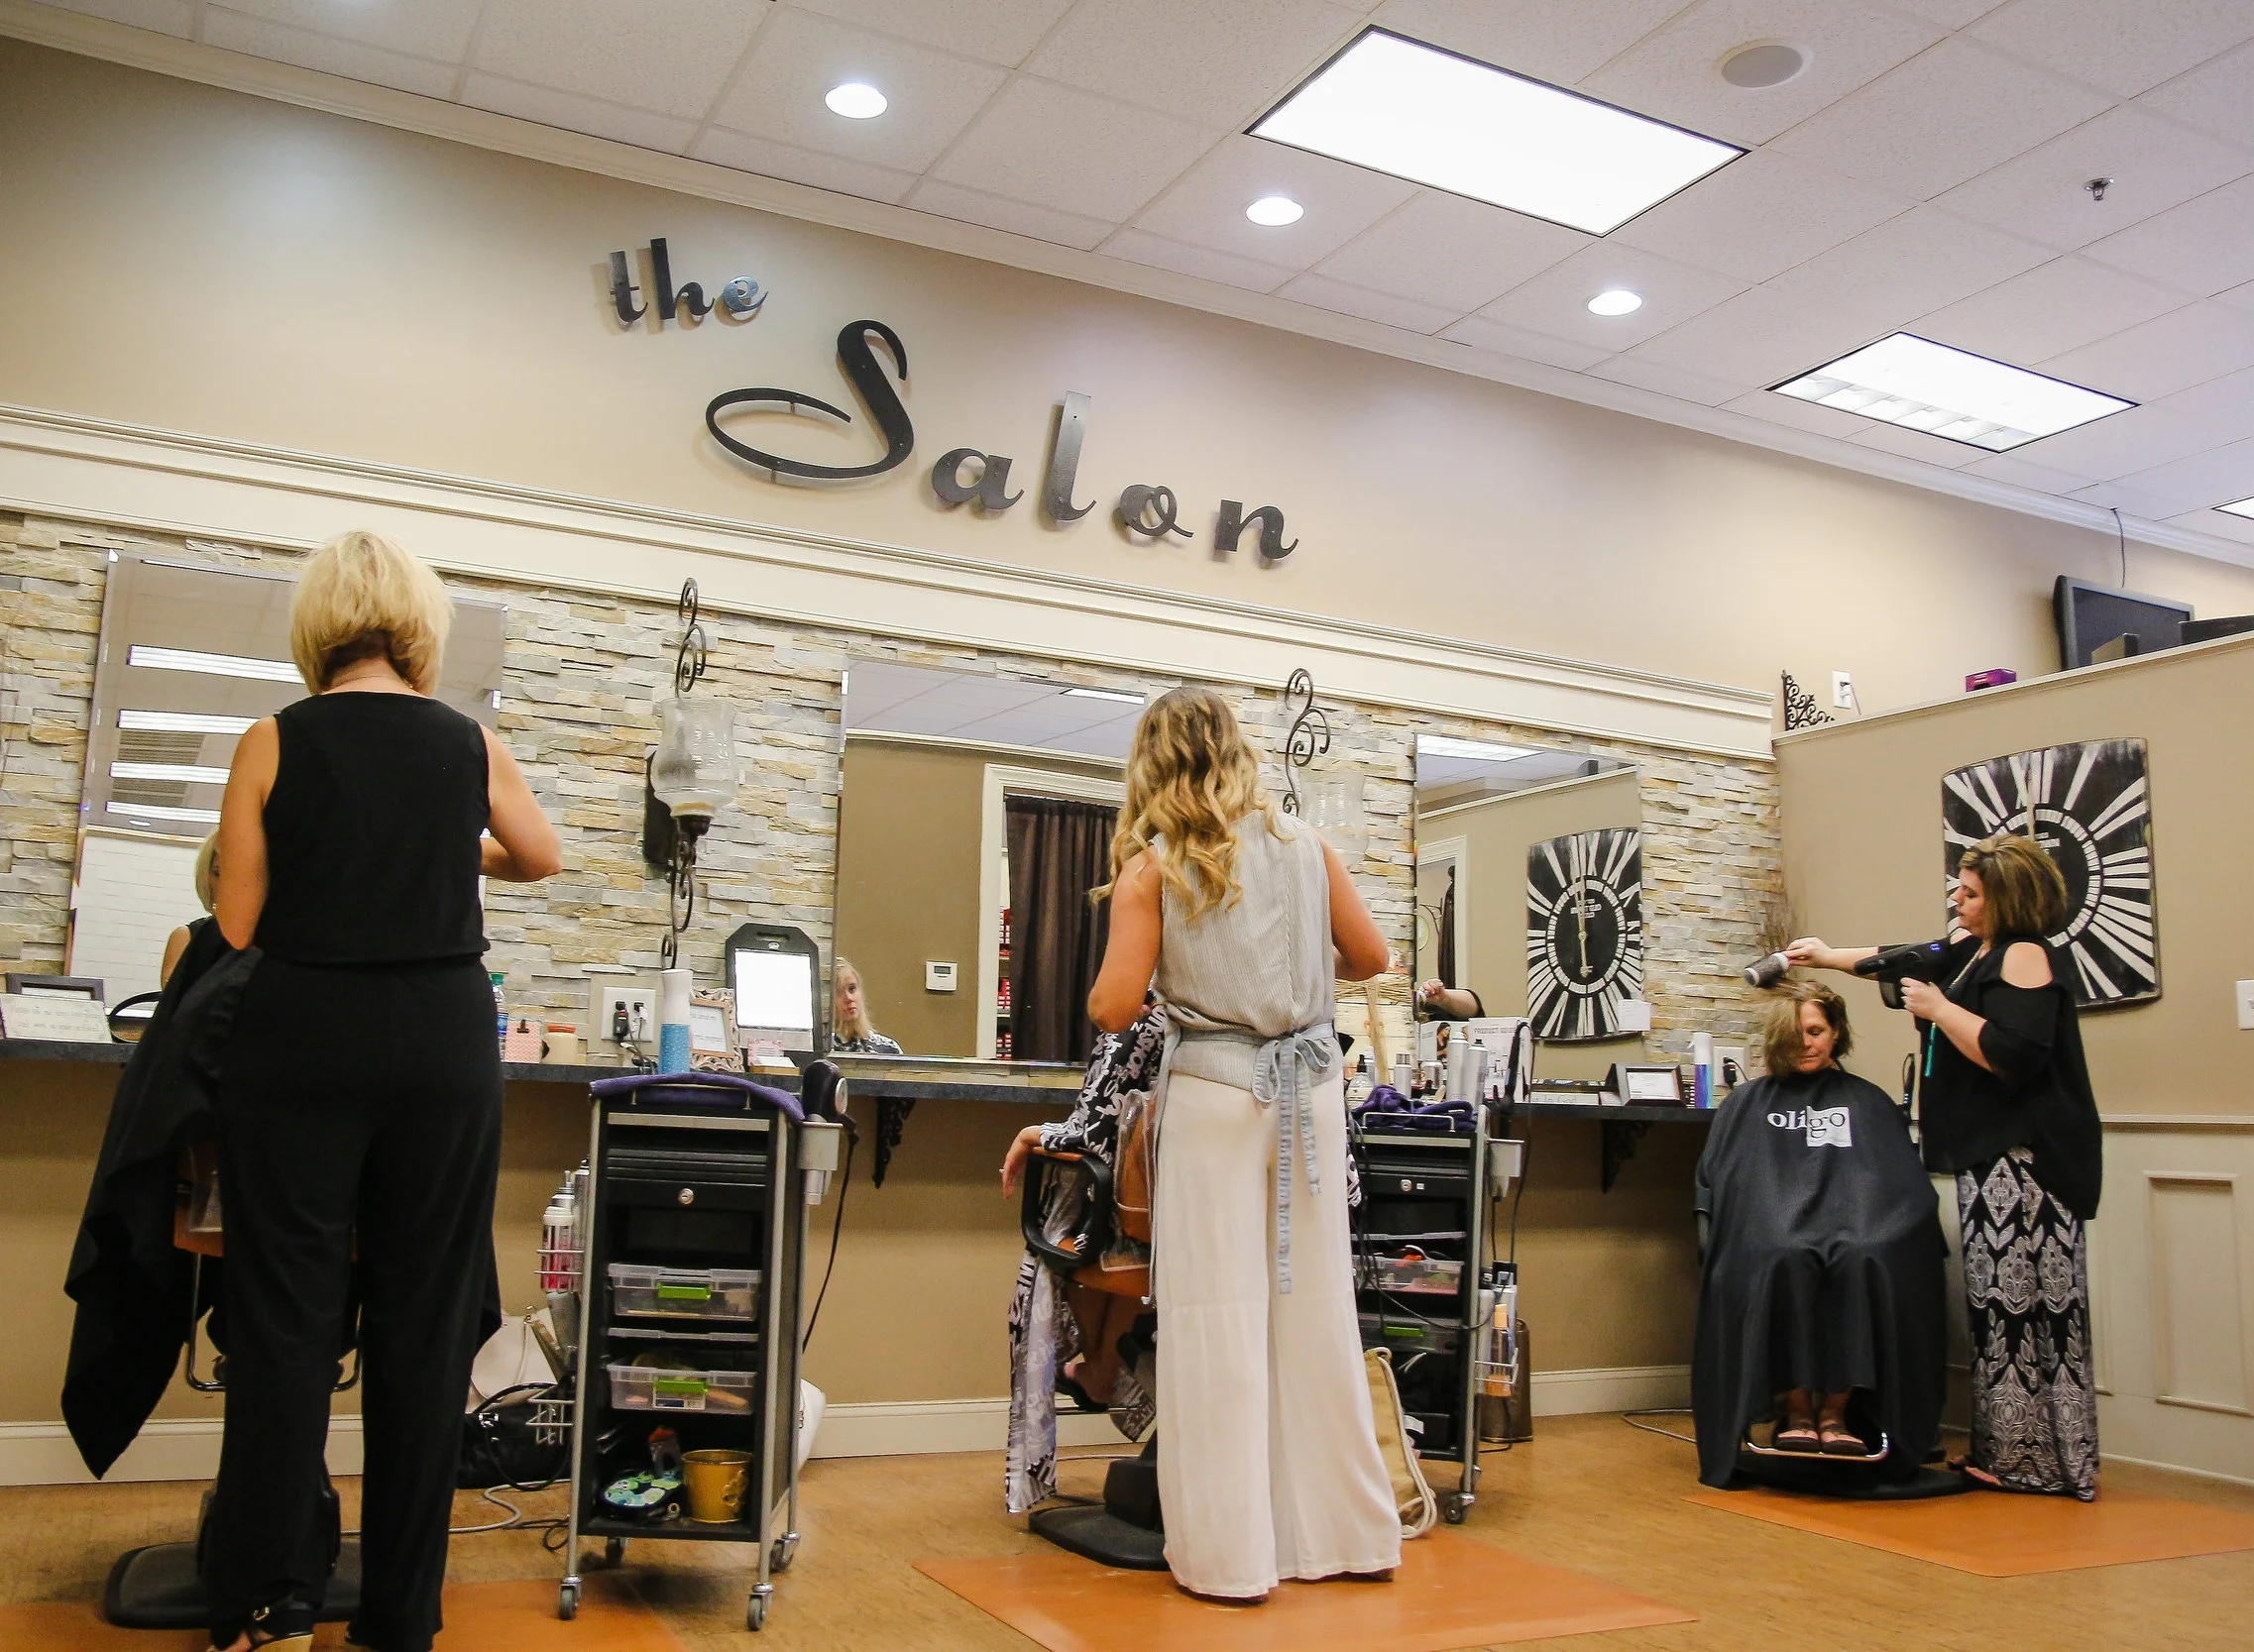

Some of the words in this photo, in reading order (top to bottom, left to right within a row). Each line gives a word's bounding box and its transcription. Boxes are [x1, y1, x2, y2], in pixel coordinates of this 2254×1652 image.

[609, 238, 769, 323] the
[706, 320, 1299, 560] Salon
[1767, 1109, 1846, 1139] oligo
